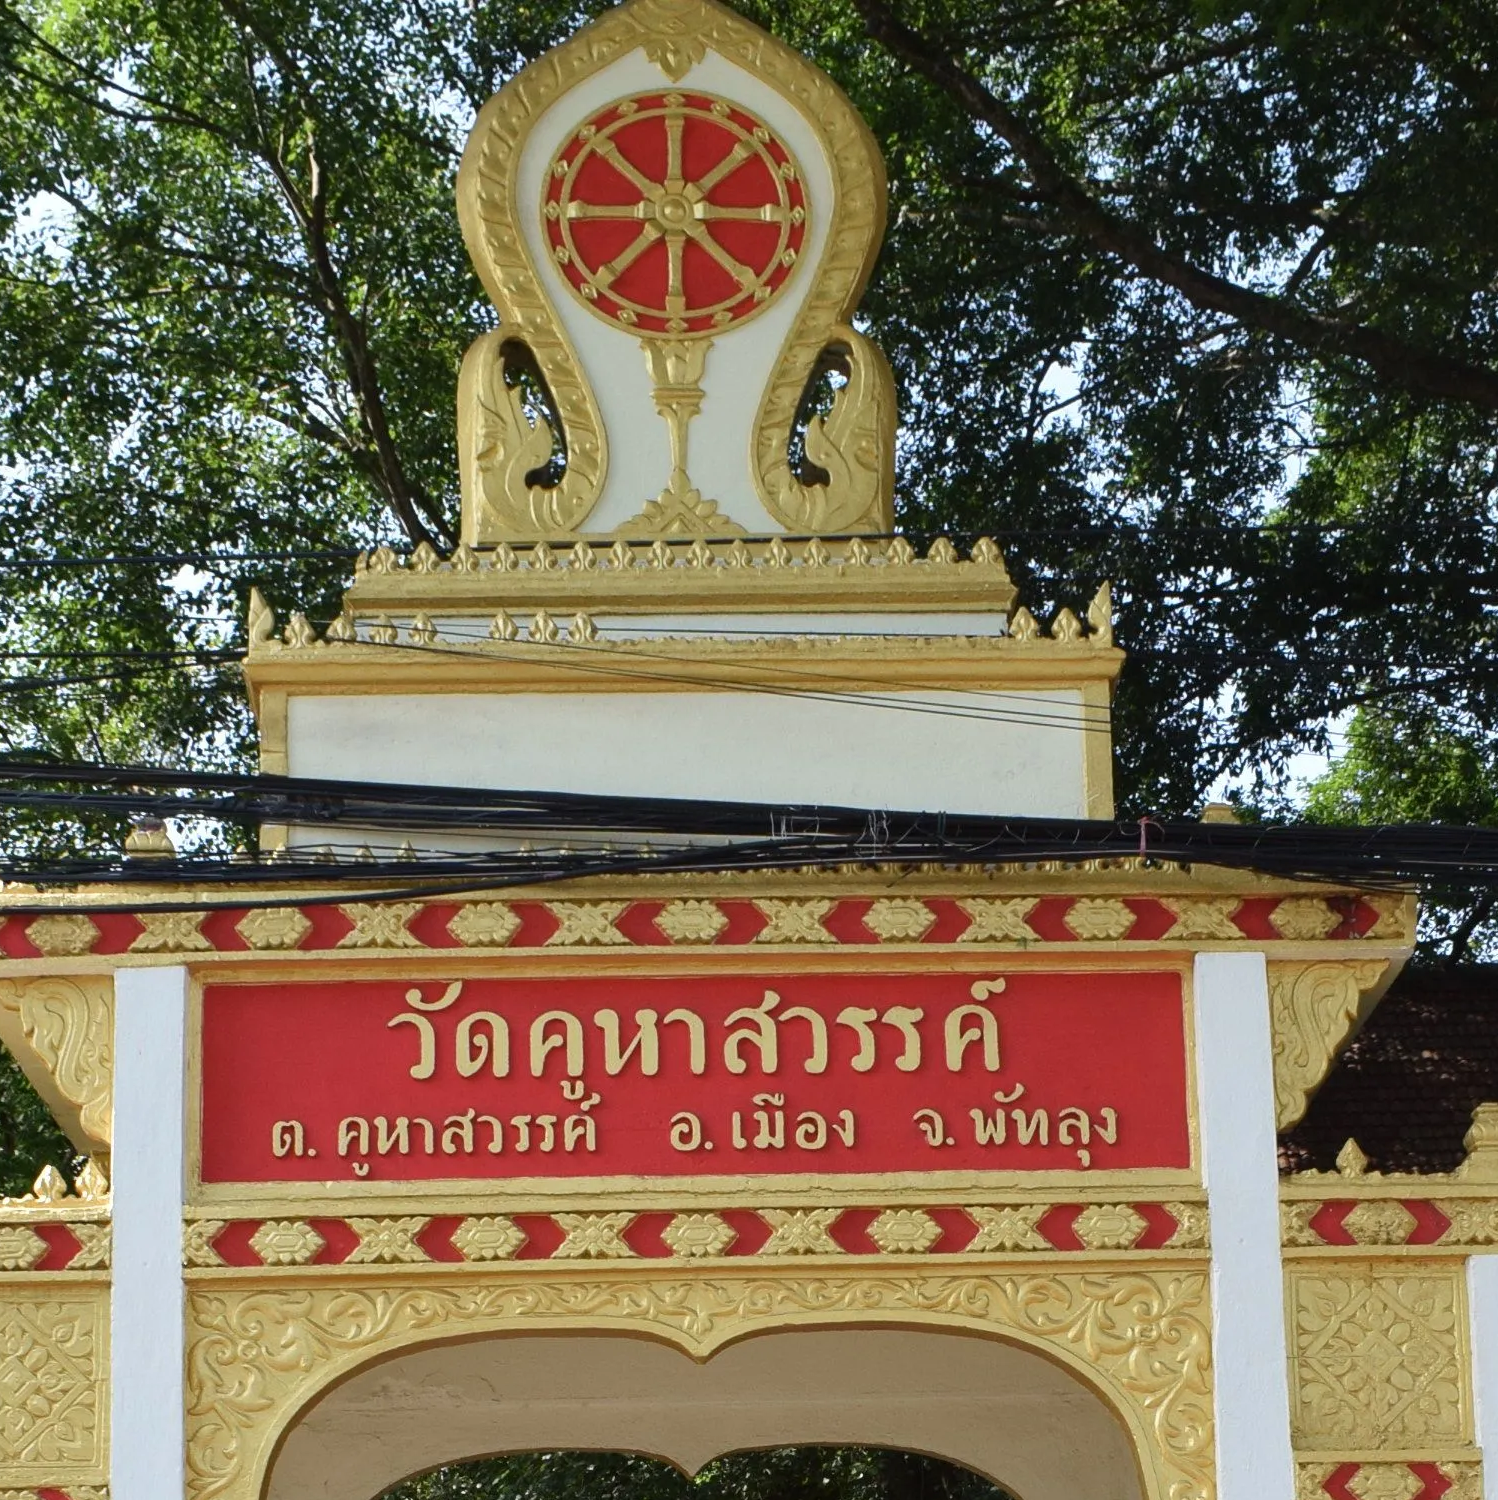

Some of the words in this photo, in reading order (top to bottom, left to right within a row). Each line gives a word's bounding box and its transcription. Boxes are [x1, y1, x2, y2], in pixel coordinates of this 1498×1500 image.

[387, 977, 1006, 1100] วัดคูหาสวรรค์
[337, 1092, 601, 1177] คูหาสวรรค์
